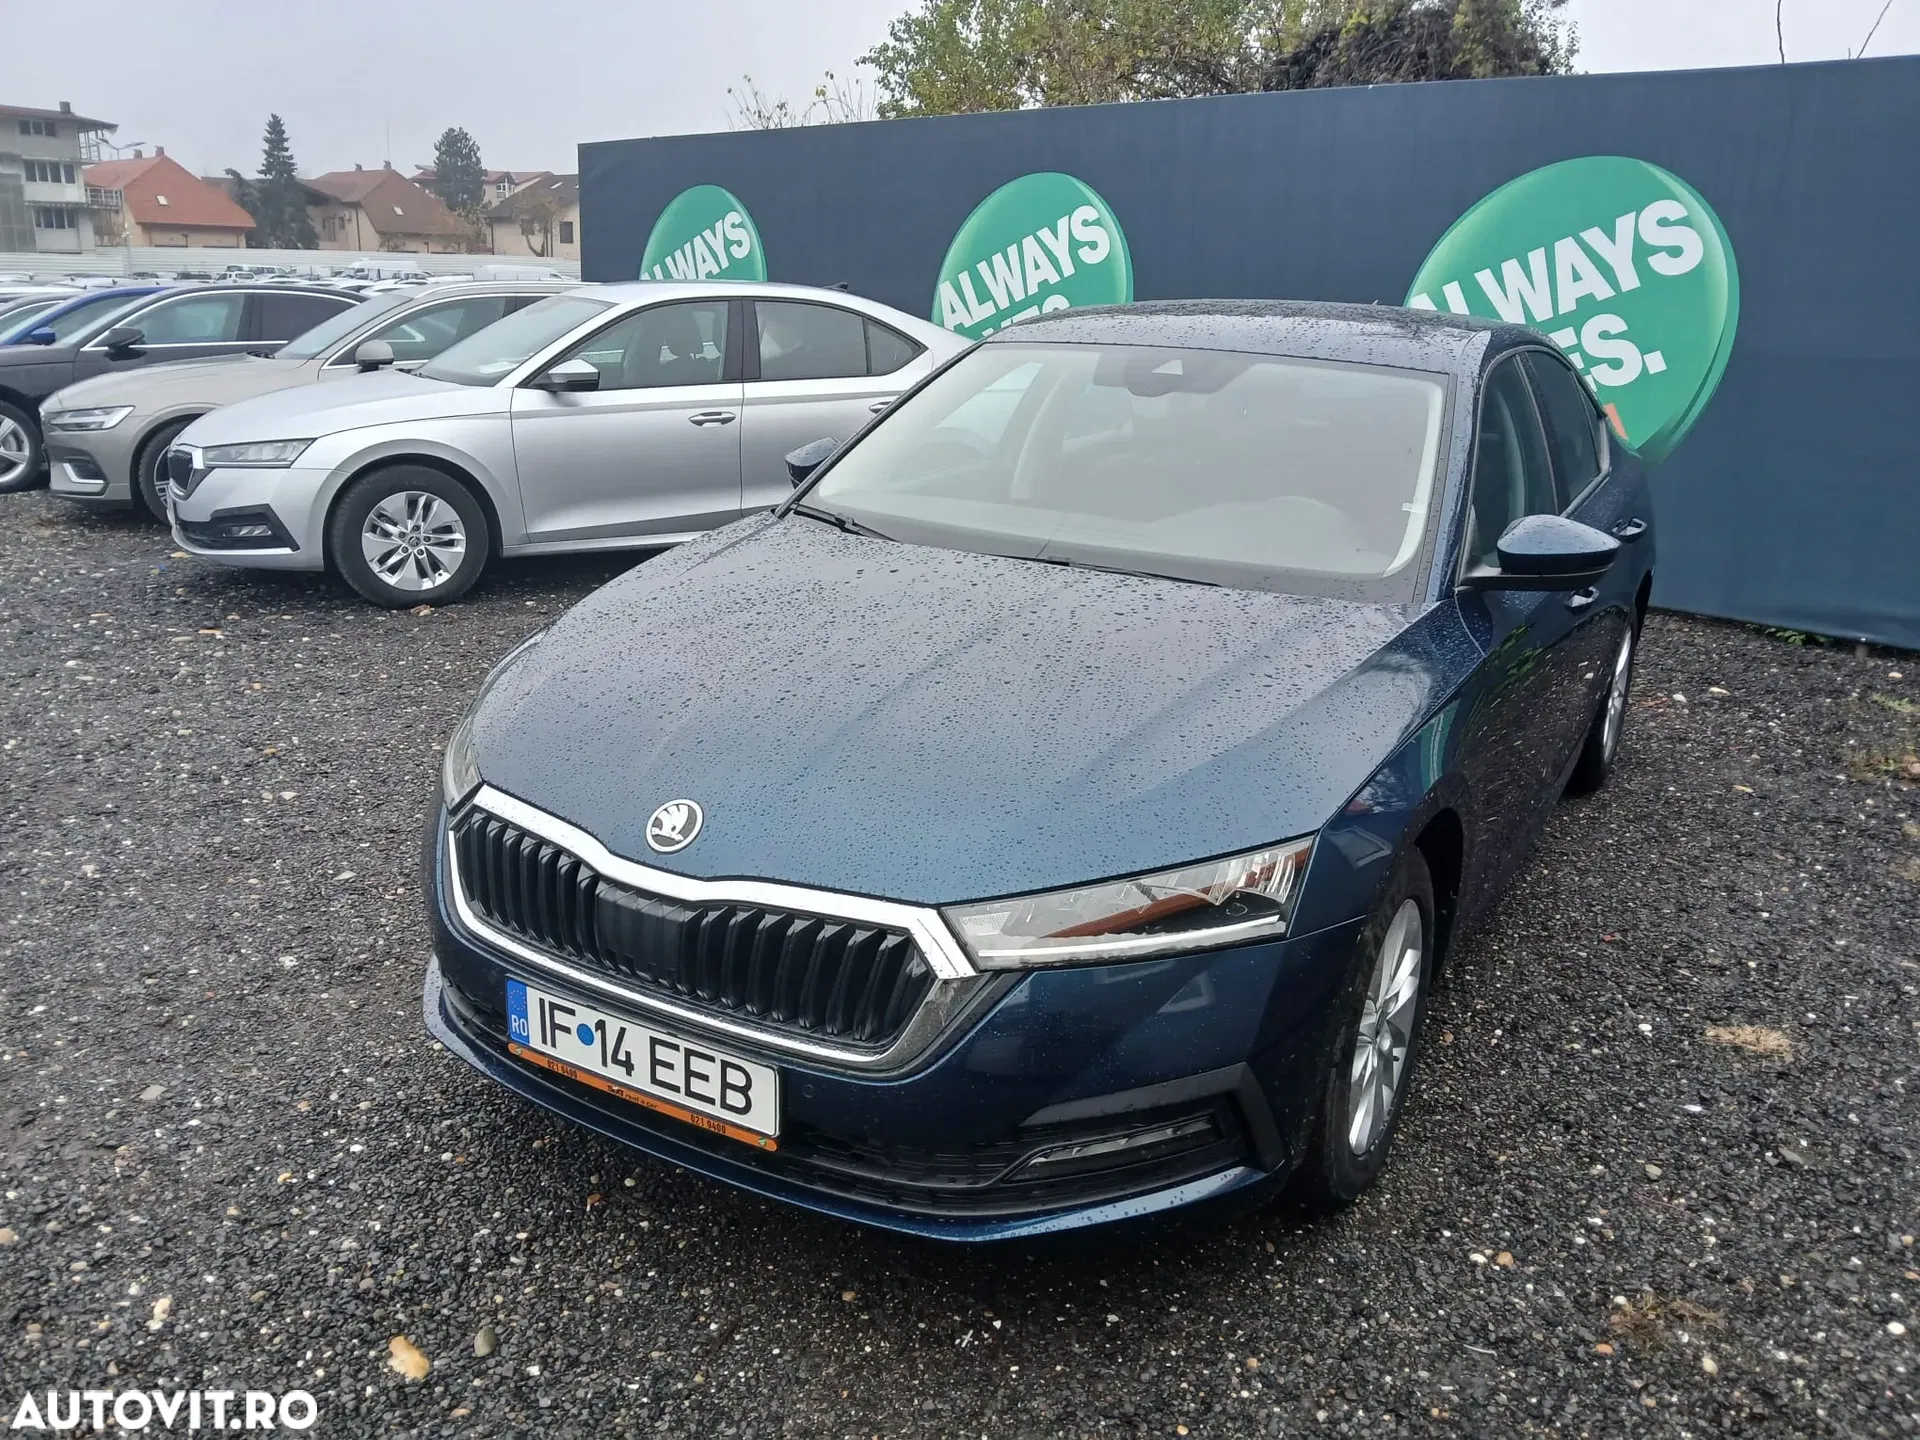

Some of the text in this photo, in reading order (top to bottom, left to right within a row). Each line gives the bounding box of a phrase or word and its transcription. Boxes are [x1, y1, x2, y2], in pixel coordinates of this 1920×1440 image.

[641, 211, 751, 280] WAYS
[939, 205, 1110, 331] ALWAYS
[1409, 199, 1704, 324] WAYS
[511, 1014, 528, 1036] RO
[539, 997, 753, 1116] IF 14 EEB
[690, 1114, 726, 1135] 021 9400
